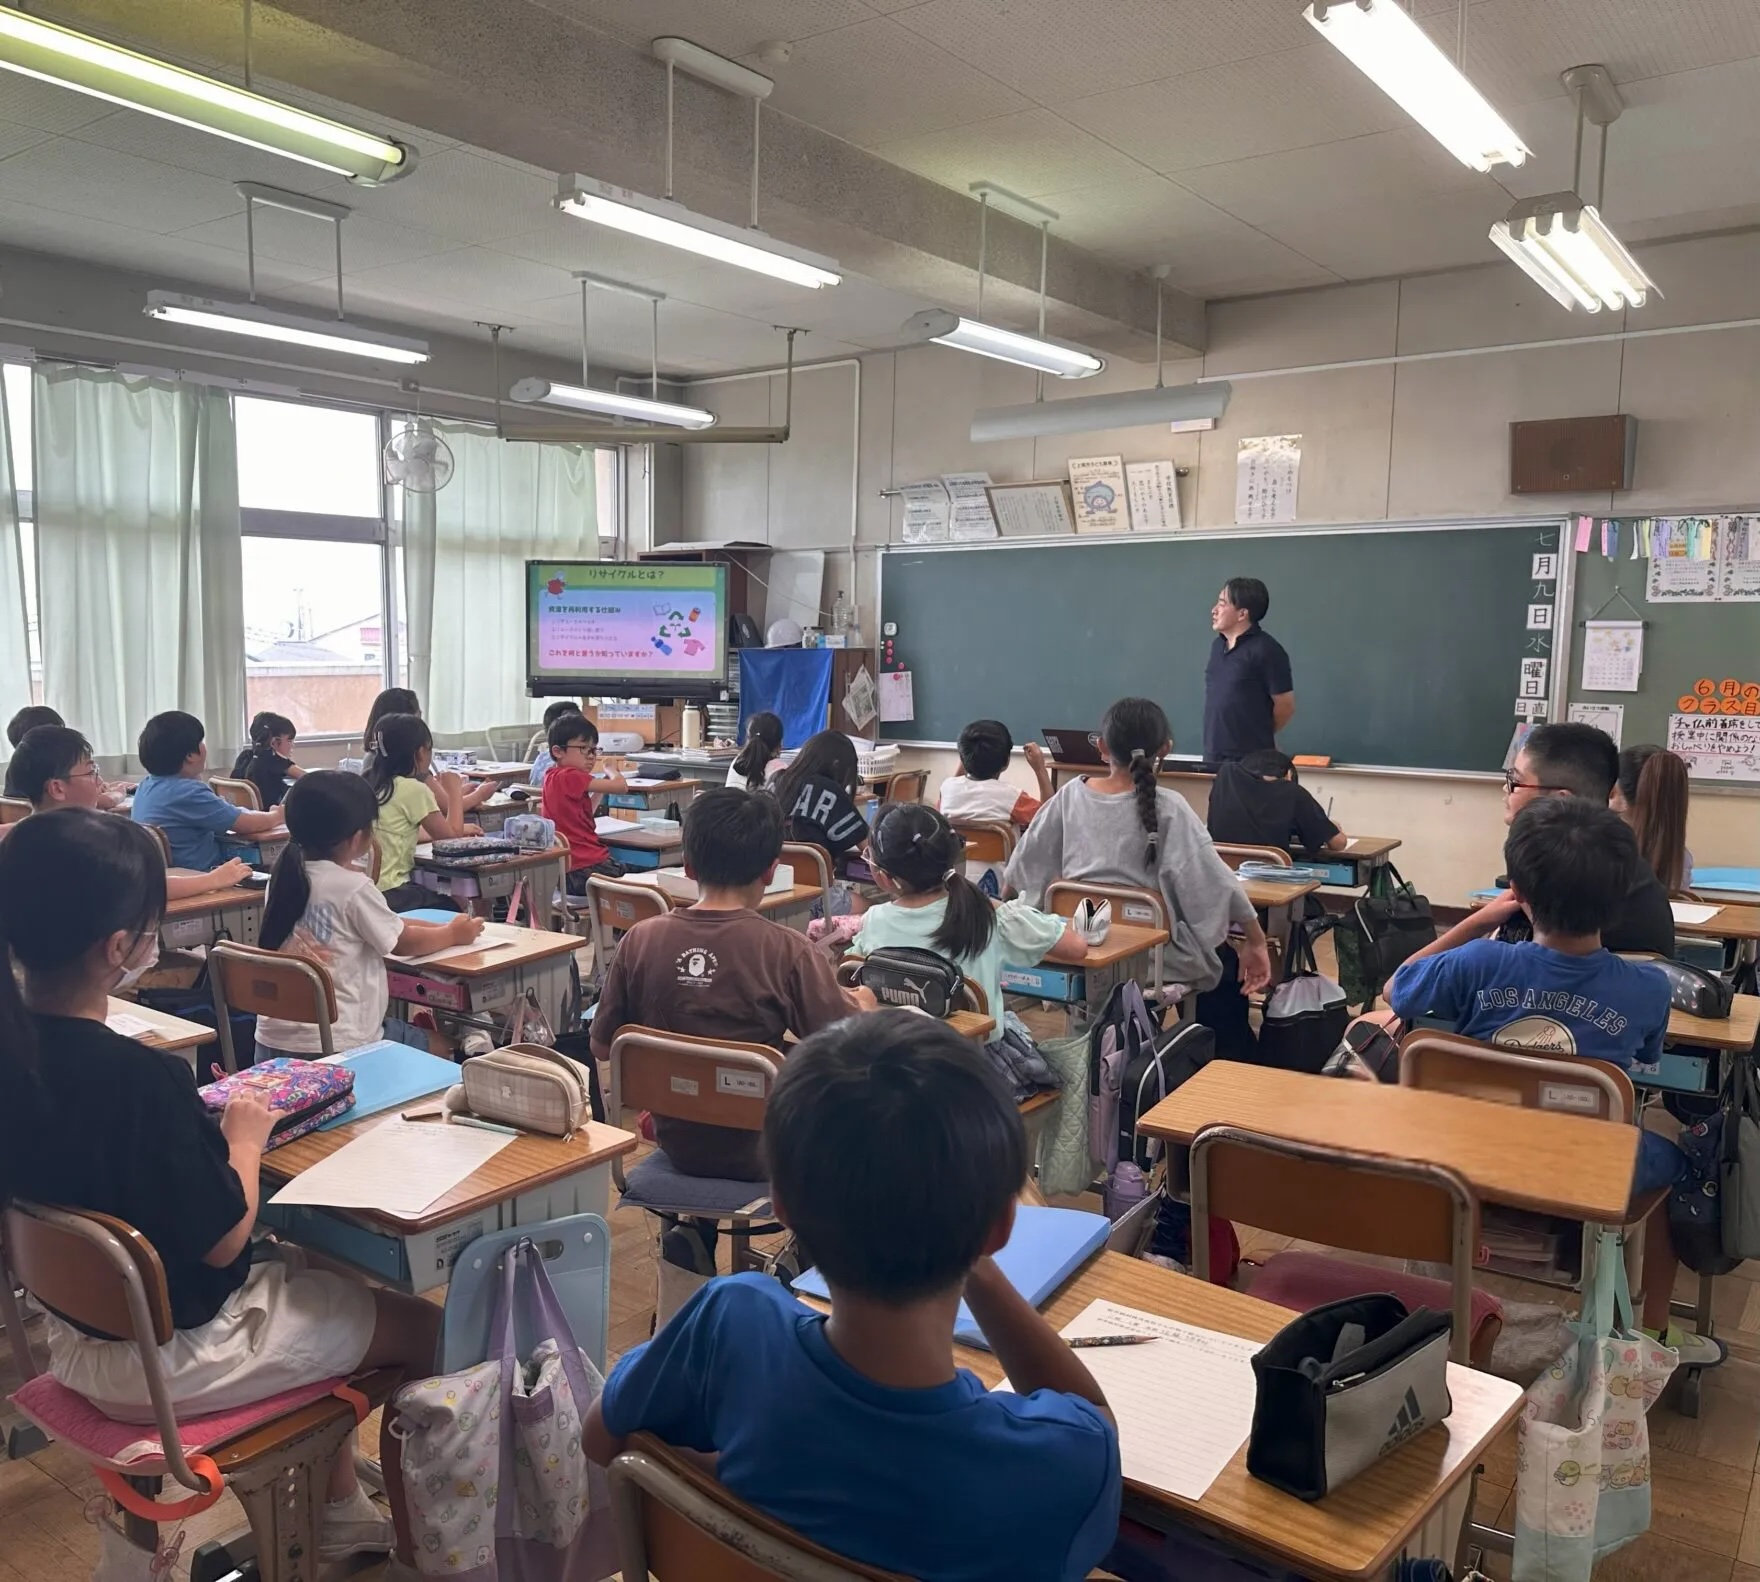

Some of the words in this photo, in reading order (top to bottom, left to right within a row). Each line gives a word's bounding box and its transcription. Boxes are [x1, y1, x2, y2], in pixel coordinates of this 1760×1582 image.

[1516, 702, 1546, 715] 日直
[1672, 730, 1760, 743] 授業中に関係のな
[881, 986, 920, 1007] PUMA
[1477, 987, 1519, 1011] LOS
[1522, 989, 1628, 1036] ANGELES
[724, 1076, 731, 1086] L
